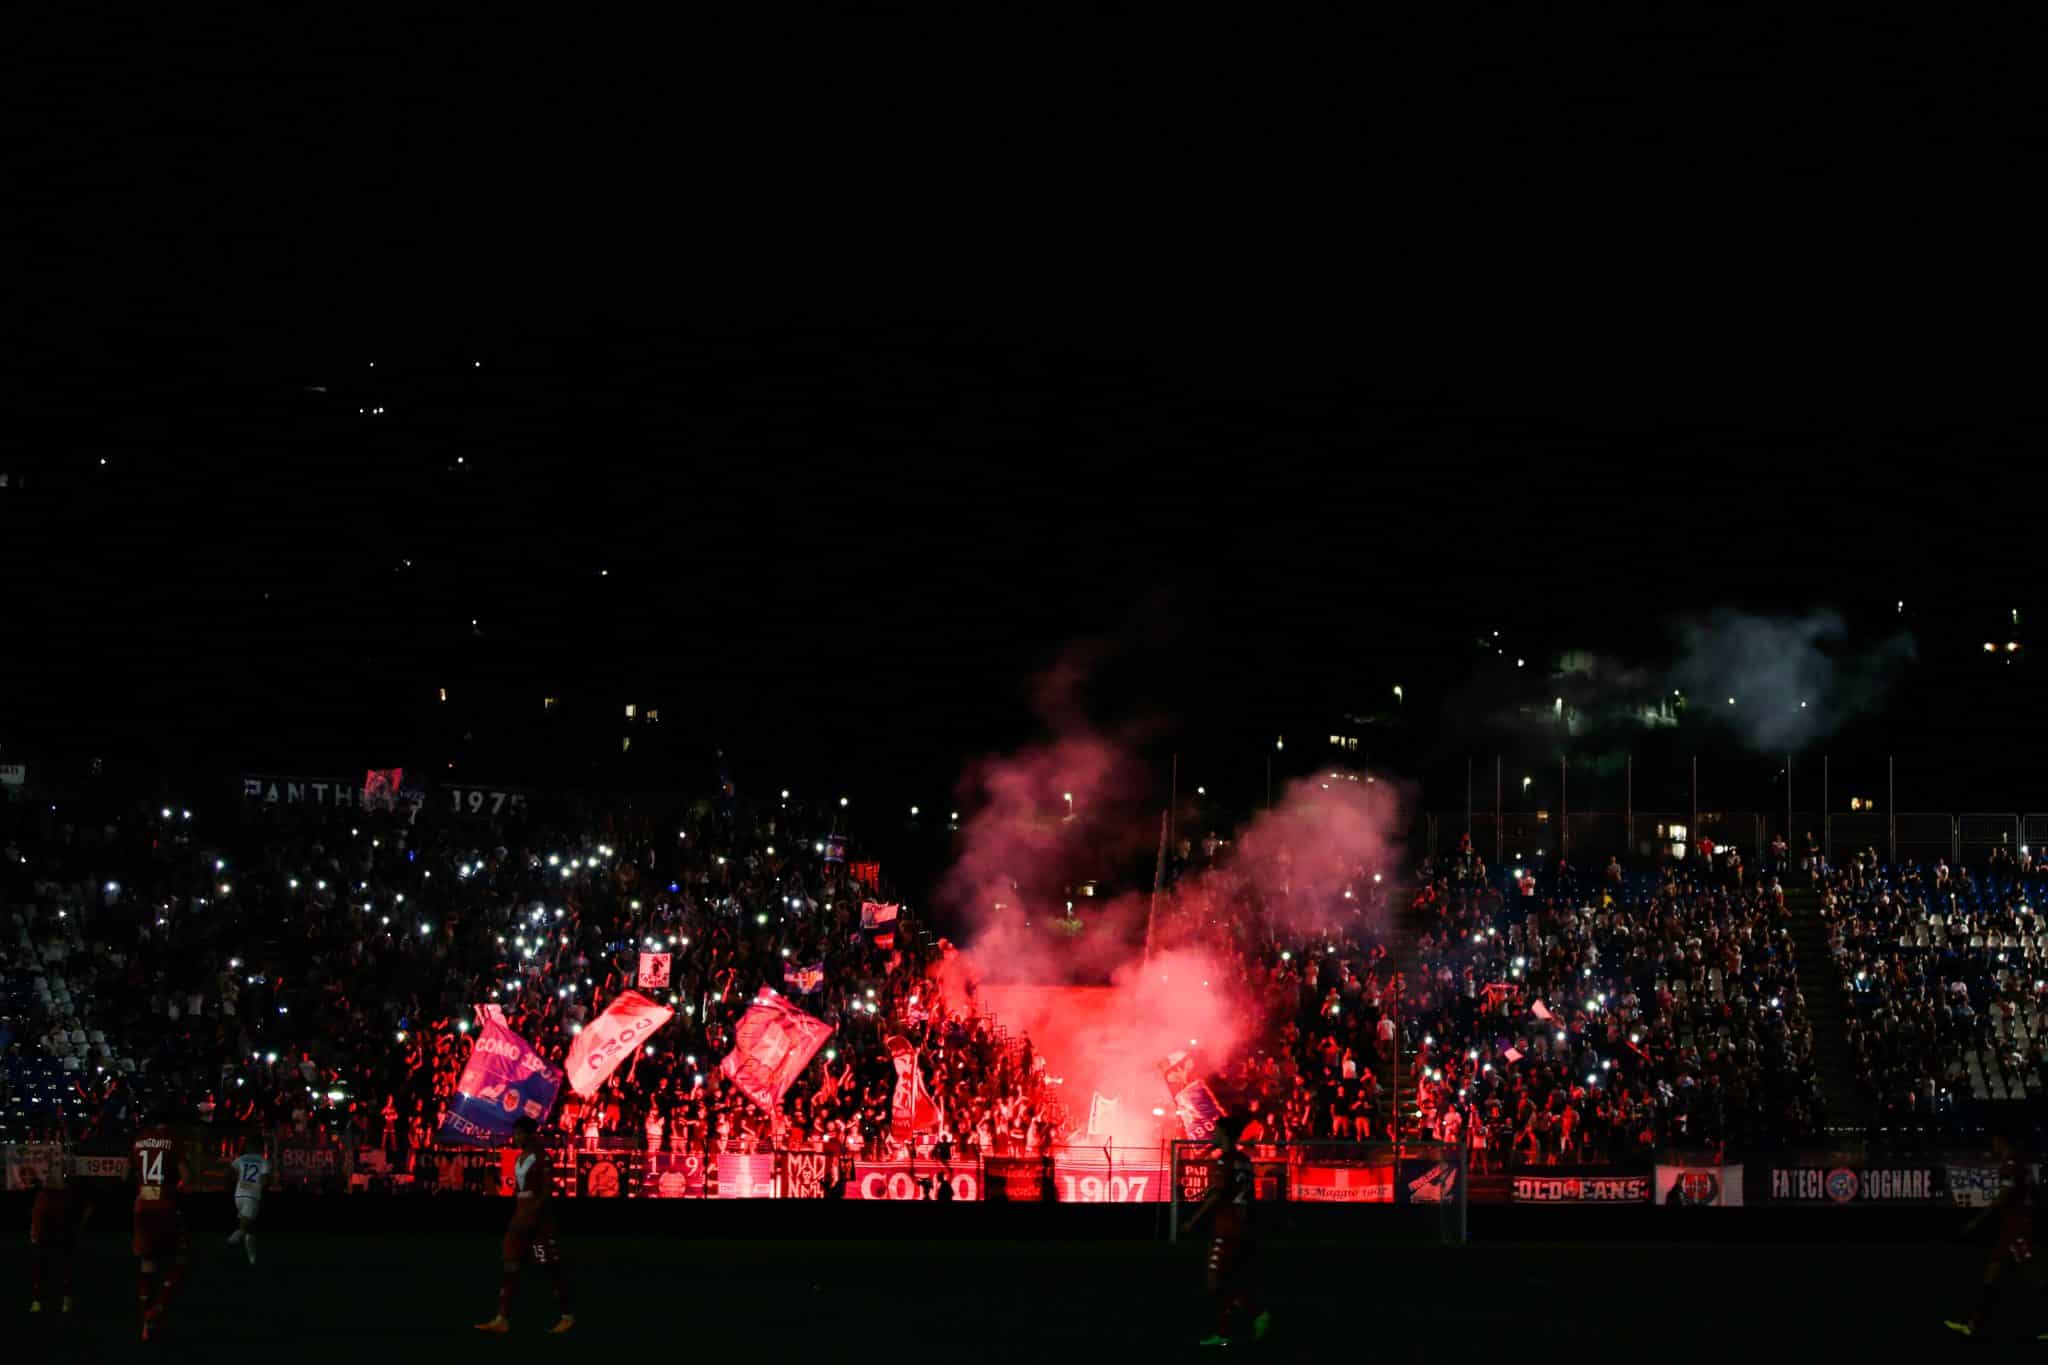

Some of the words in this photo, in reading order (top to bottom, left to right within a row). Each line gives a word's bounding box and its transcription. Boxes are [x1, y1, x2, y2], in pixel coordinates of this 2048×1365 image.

[475, 1038, 520, 1060] COMO
[138, 1150, 165, 1185] 14
[242, 1164, 258, 1183] 12
[861, 1172, 977, 1201] COO
[1063, 1175, 1149, 1203] 1907
[1519, 1180, 1562, 1199] OLD
[1772, 1168, 1824, 1199] FATECI
